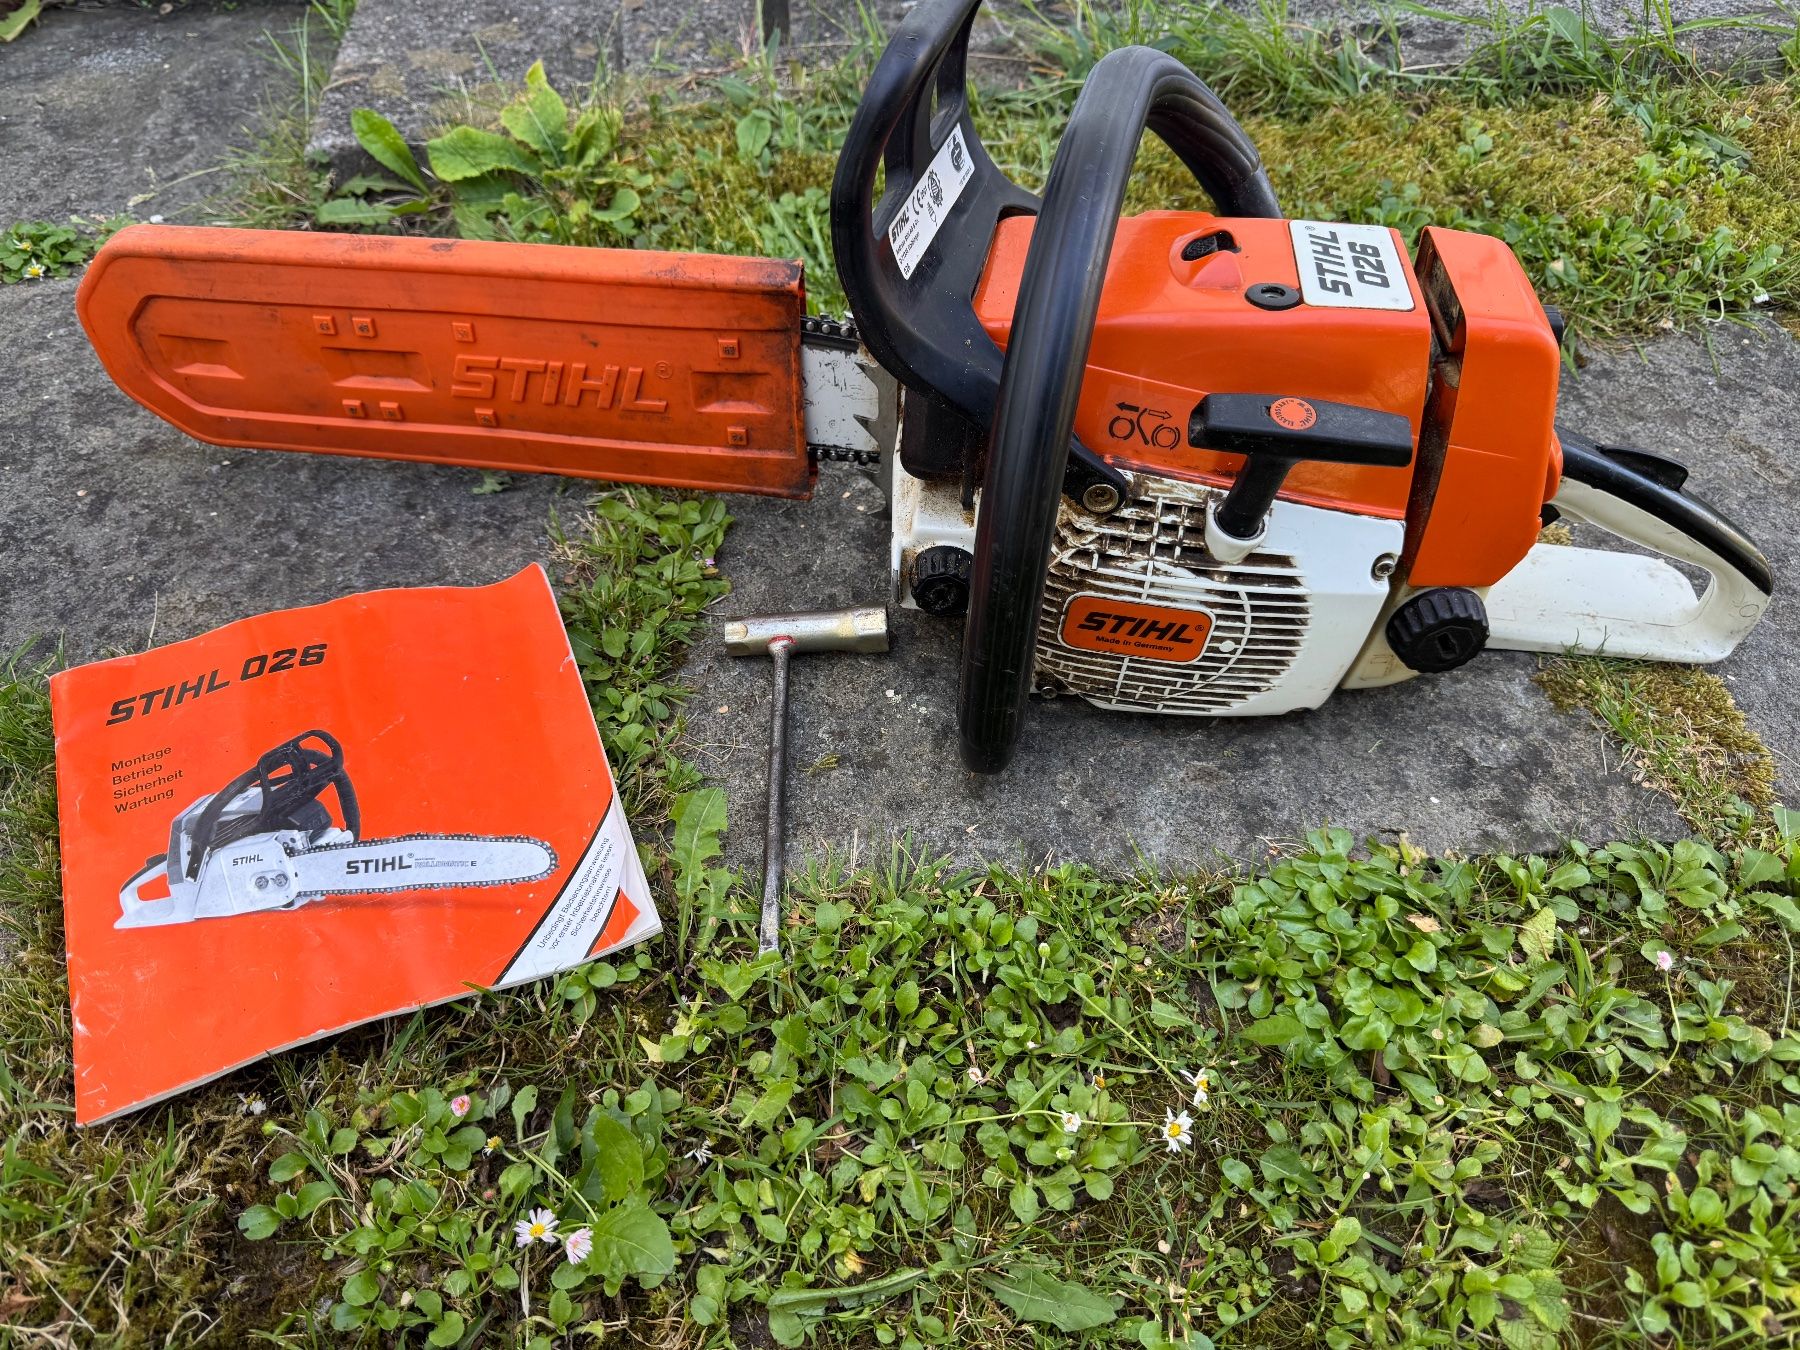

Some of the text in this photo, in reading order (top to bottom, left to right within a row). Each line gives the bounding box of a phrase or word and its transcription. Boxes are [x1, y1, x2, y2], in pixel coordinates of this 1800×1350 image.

[1308, 230, 1354, 297] STIHL
[1347, 241, 1391, 289] 026
[451, 354, 669, 413] STIHL
[1077, 611, 1195, 644] STIHL
[1095, 635, 1120, 645] Made
[1134, 641, 1175, 652] Germany
[105, 643, 328, 726] STIHL 026
[111, 747, 172, 771] Montage
[112, 763, 163, 786] Betrieb
[113, 769, 183, 800] Sicherheit
[114, 788, 174, 814] Wartung
[232, 853, 264, 867] STIHL
[345, 855, 412, 875] STIHL
[537, 837, 610, 949] Unbedingt Bedienungsanweisung
[551, 938, 561, 950] vor
[559, 917, 573, 939] erster
[570, 863, 605, 918] Inbetriebnahme
[570, 867, 612, 937] Sicherheitshinweise
